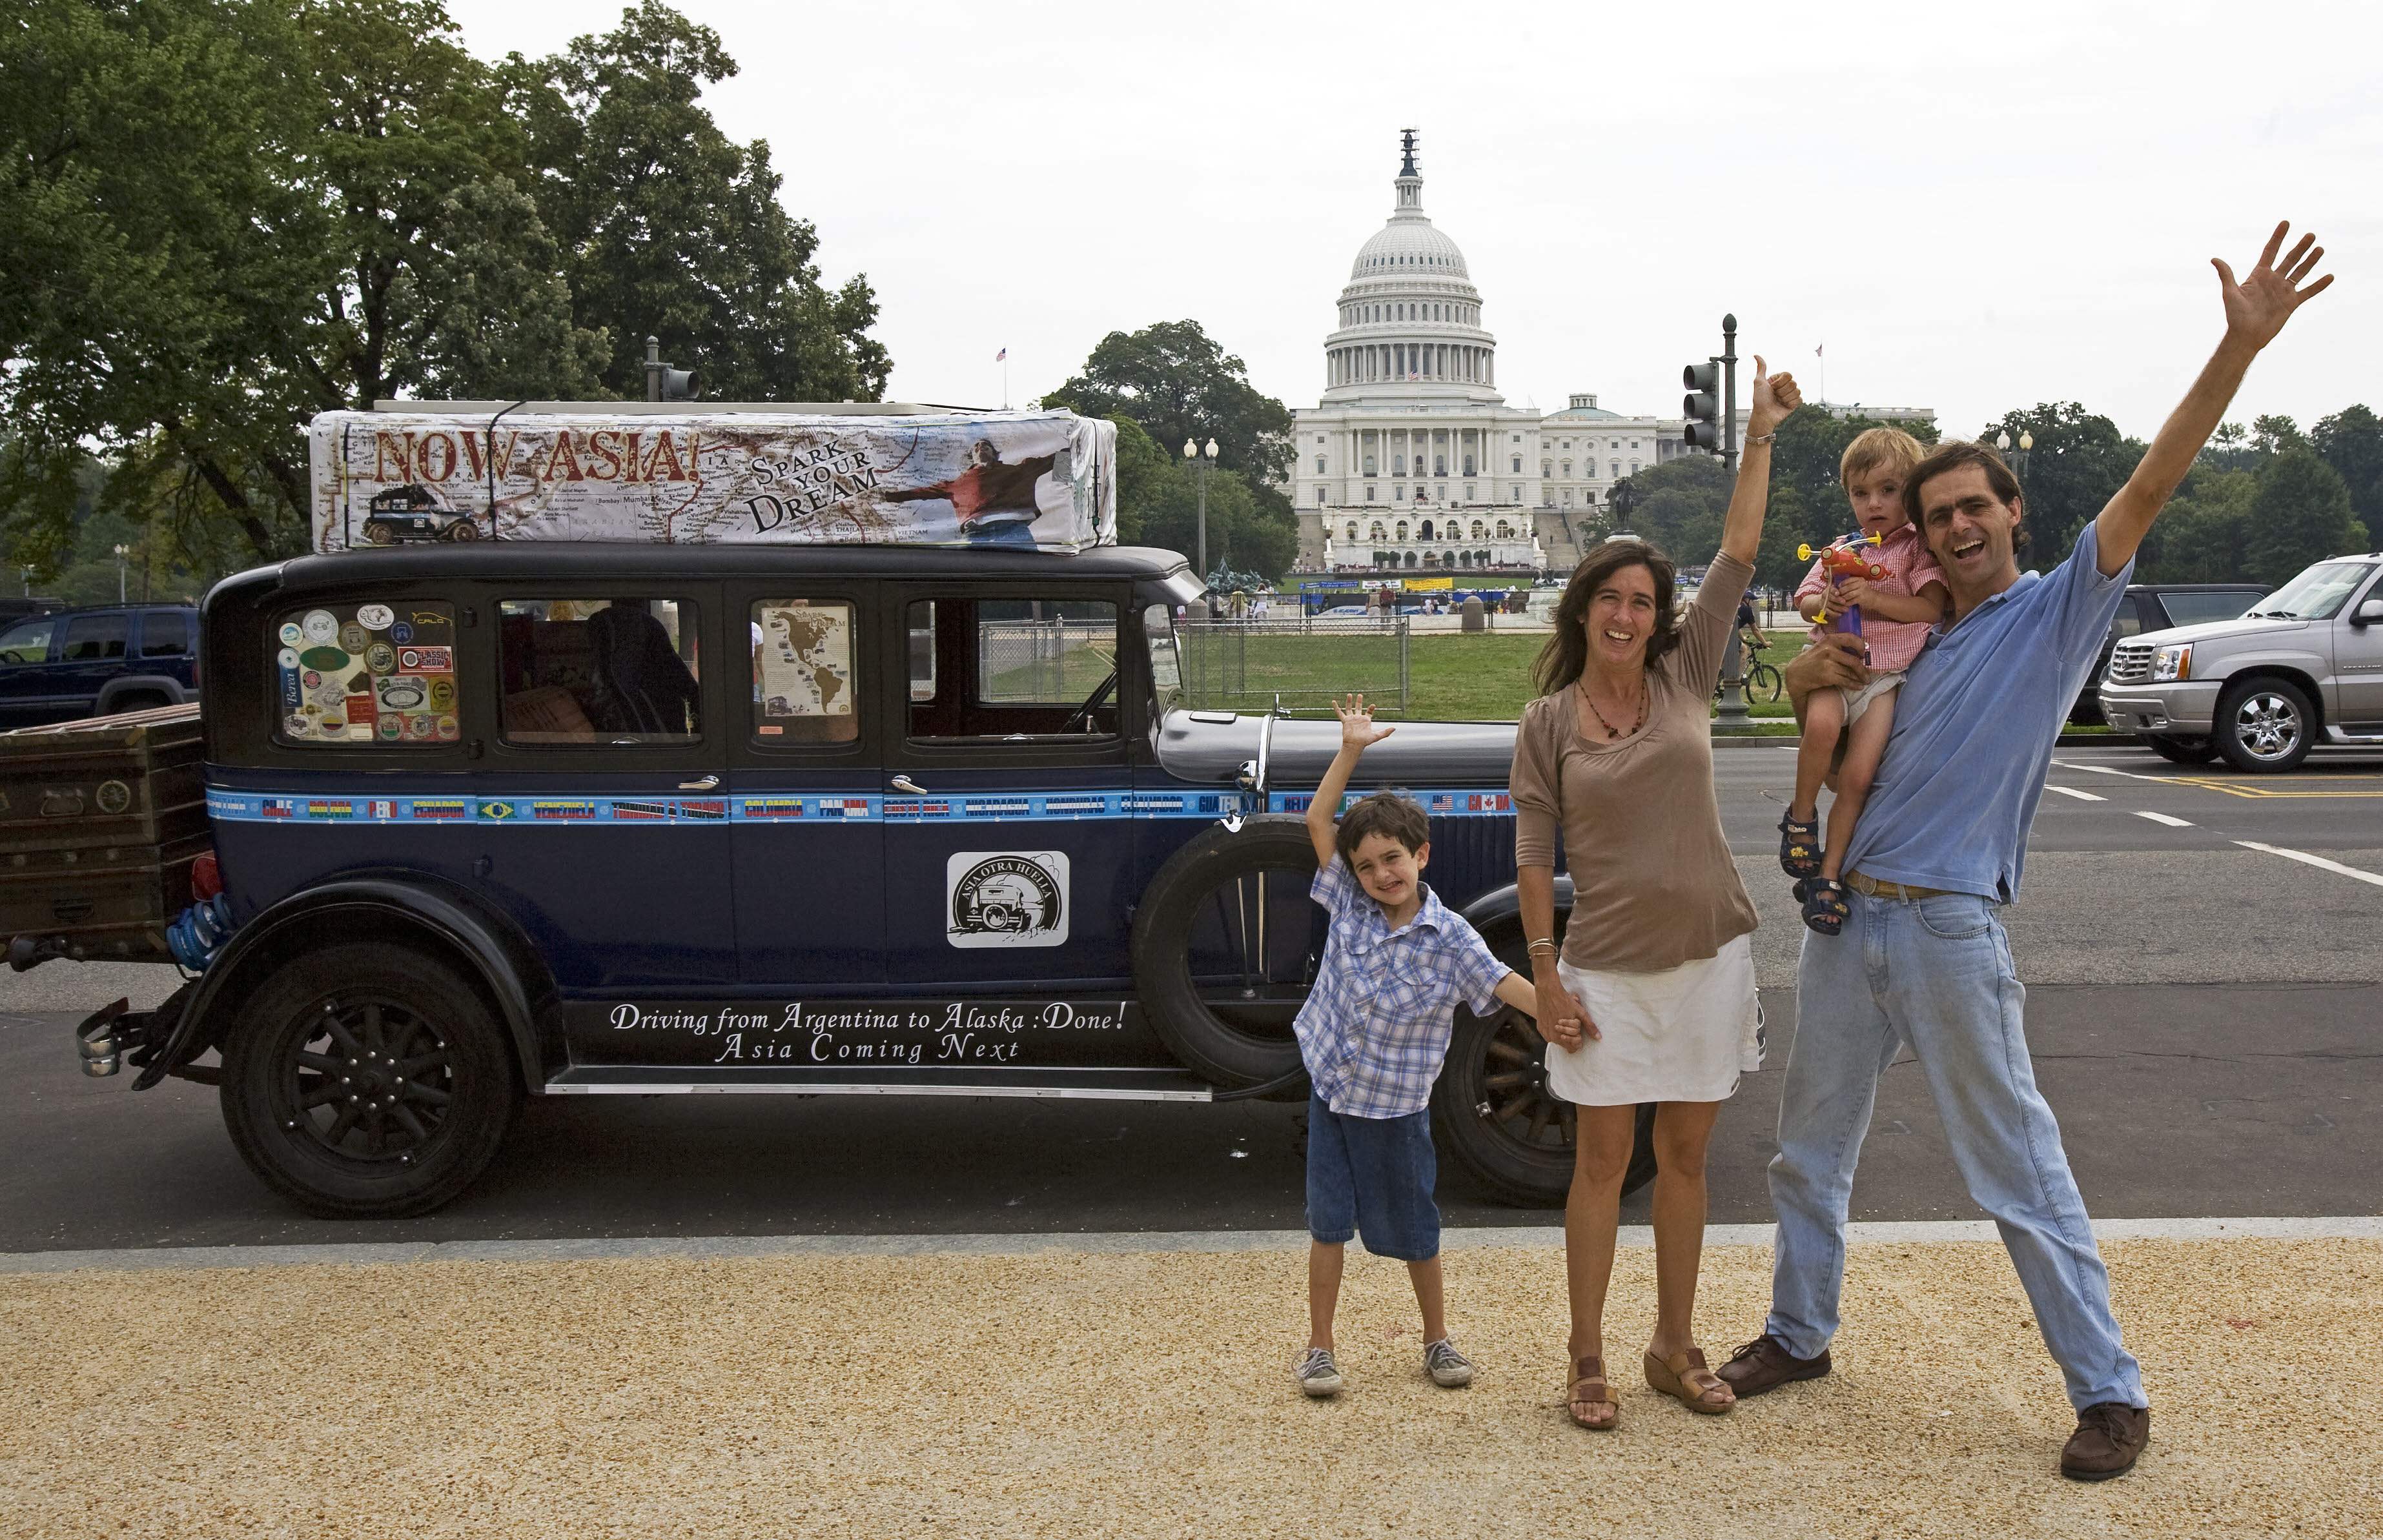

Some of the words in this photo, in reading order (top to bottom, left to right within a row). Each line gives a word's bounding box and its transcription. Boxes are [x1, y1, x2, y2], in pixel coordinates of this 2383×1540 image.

[374, 431, 520, 482] NOW
[542, 430, 699, 482] ASIA!
[752, 440, 846, 486] SPARK
[793, 452, 870, 489] YOUR
[744, 467, 881, 534] DREAM
[417, 651, 450, 661] CLASSIC
[368, 801, 398, 818] PERU
[533, 802, 596, 818] VENEZUELA
[745, 800, 803, 817] COLOMBIA
[819, 800, 868, 816] PANAMA
[966, 798, 1030, 816] NICARAGUA
[1046, 796, 1105, 815] HONDURAS
[1468, 795, 1510, 811] CANADA
[962, 877, 981, 900] ASIA
[981, 862, 1012, 876] OTRA
[1016, 863, 1052, 898] HUELLA
[610, 1003, 708, 1035] Driving
[711, 1008, 768, 1035] from
[774, 1002, 899, 1034] Argentina
[908, 1012, 930, 1028] to
[935, 1002, 1025, 1033] Alaska
[715, 1033, 792, 1062] Asia
[810, 1033, 923, 1064] Coming
[938, 1033, 1018, 1061] Next
